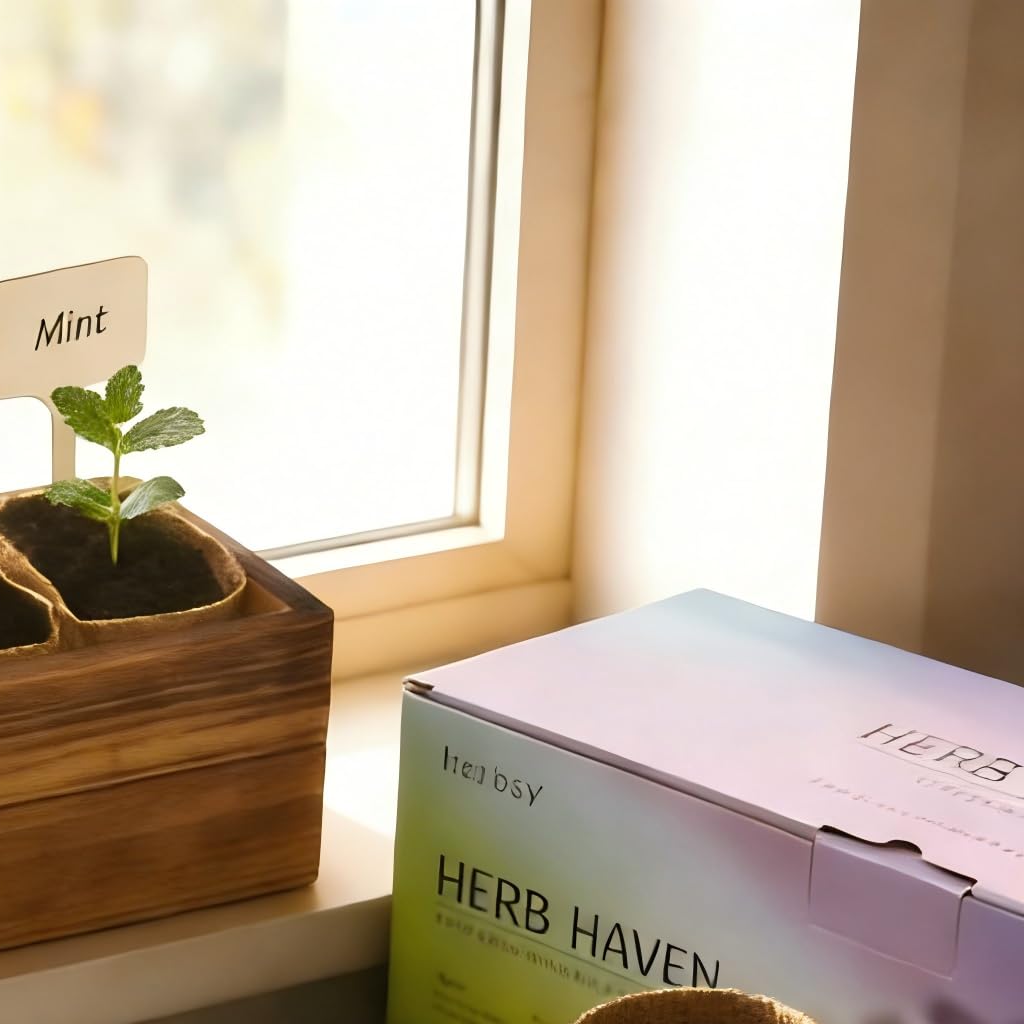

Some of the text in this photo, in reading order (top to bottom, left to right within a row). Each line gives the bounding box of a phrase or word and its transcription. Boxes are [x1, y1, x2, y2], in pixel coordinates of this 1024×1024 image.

[34, 305, 109, 352] Mint
[859, 723, 1024, 782] HERB
[437, 854, 550, 935] HERB
[571, 905, 720, 989] HAVEN
